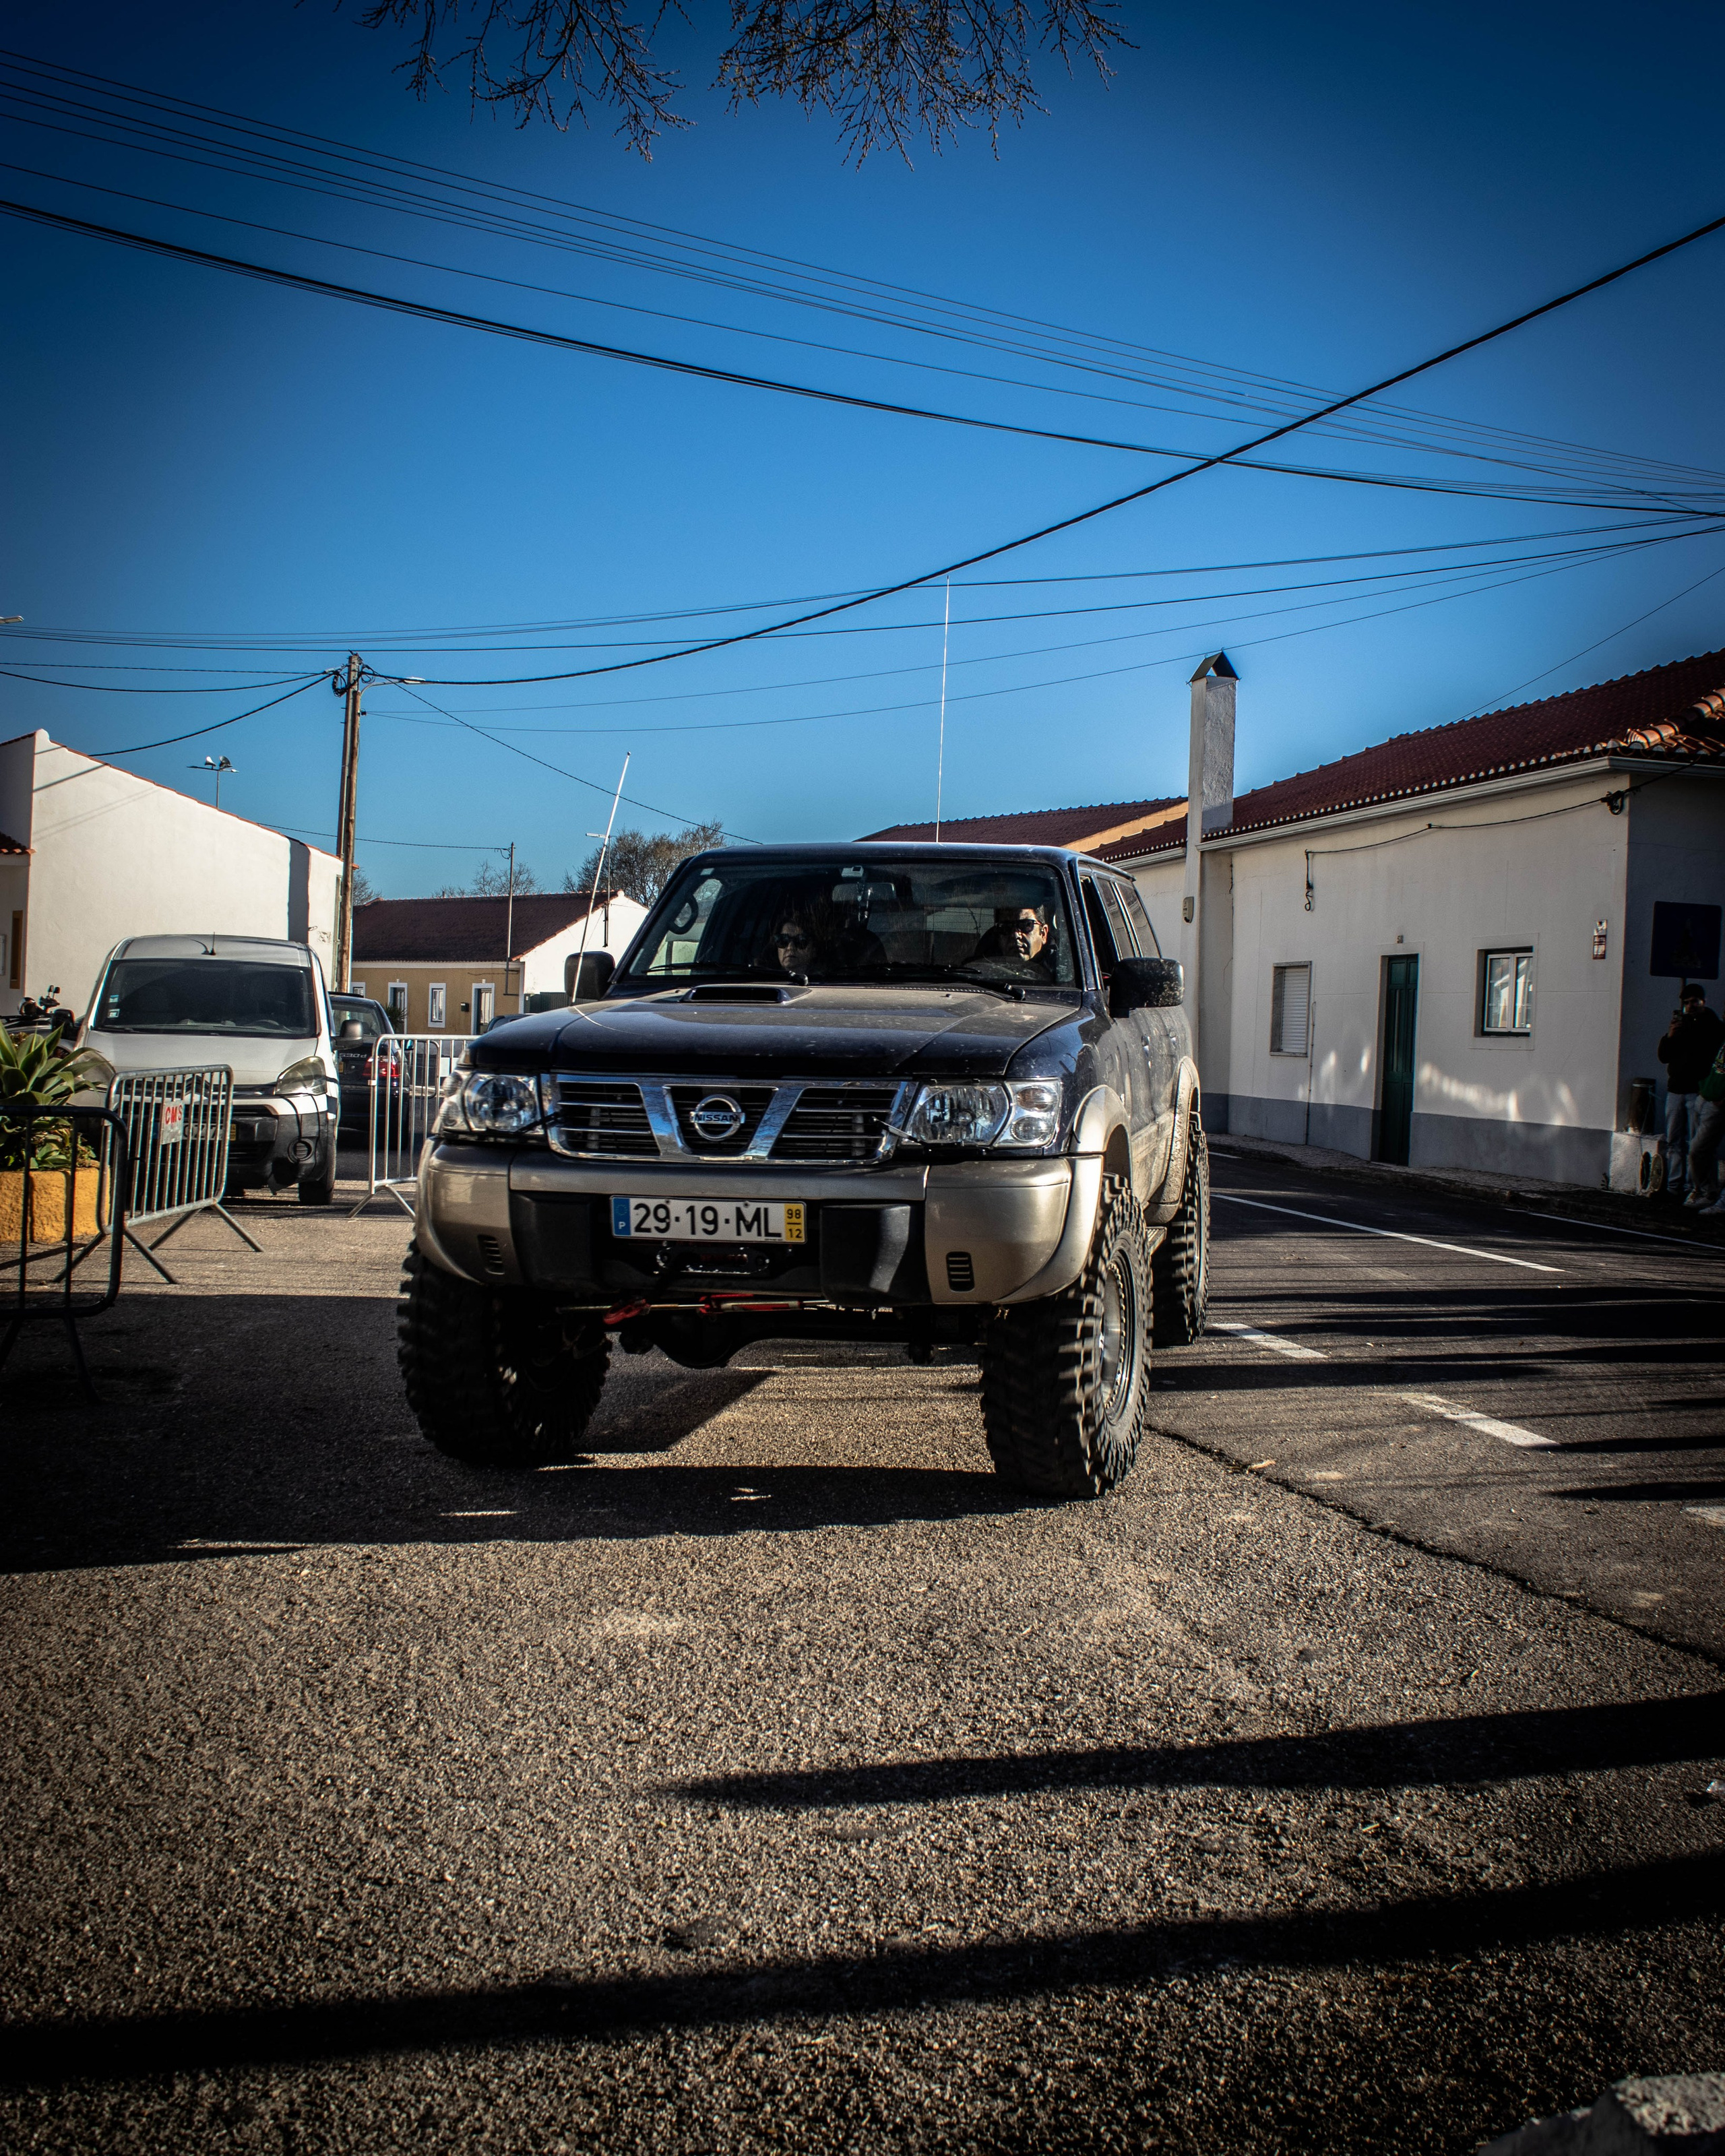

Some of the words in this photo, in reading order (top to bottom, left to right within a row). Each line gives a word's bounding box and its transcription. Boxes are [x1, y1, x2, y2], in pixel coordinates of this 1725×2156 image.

[165, 1105, 183, 1124] CMS
[695, 1114, 738, 1122] NISSAN
[786, 1209, 801, 1219] 98
[618, 1222, 626, 1230] P
[788, 1228, 803, 1238] 12
